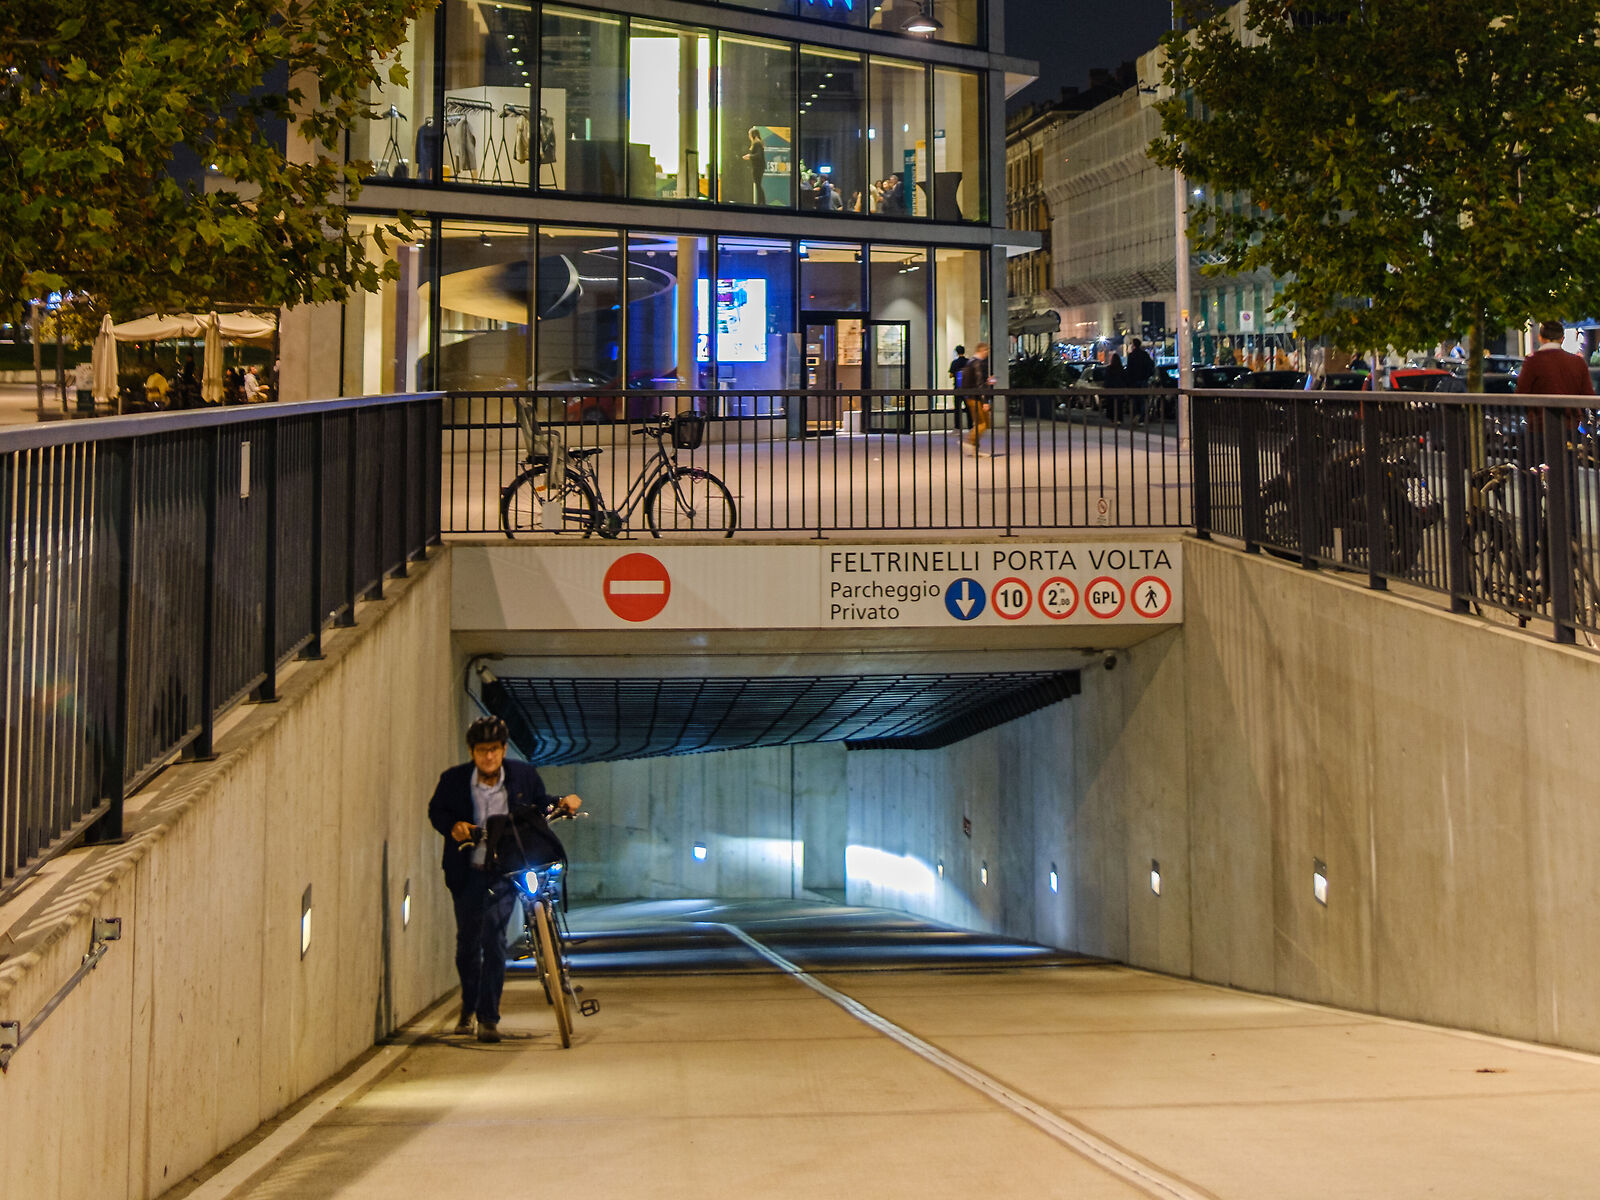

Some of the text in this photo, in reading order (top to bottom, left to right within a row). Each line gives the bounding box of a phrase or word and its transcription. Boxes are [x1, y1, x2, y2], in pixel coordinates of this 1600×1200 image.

[830, 549, 1172, 573] FELTRINELLI PORTA VOLTA
[830, 580, 941, 602] Parcheggio
[1000, 589, 1023, 608] 10
[1092, 591, 1118, 605] GPL
[830, 603, 900, 621] Privato
